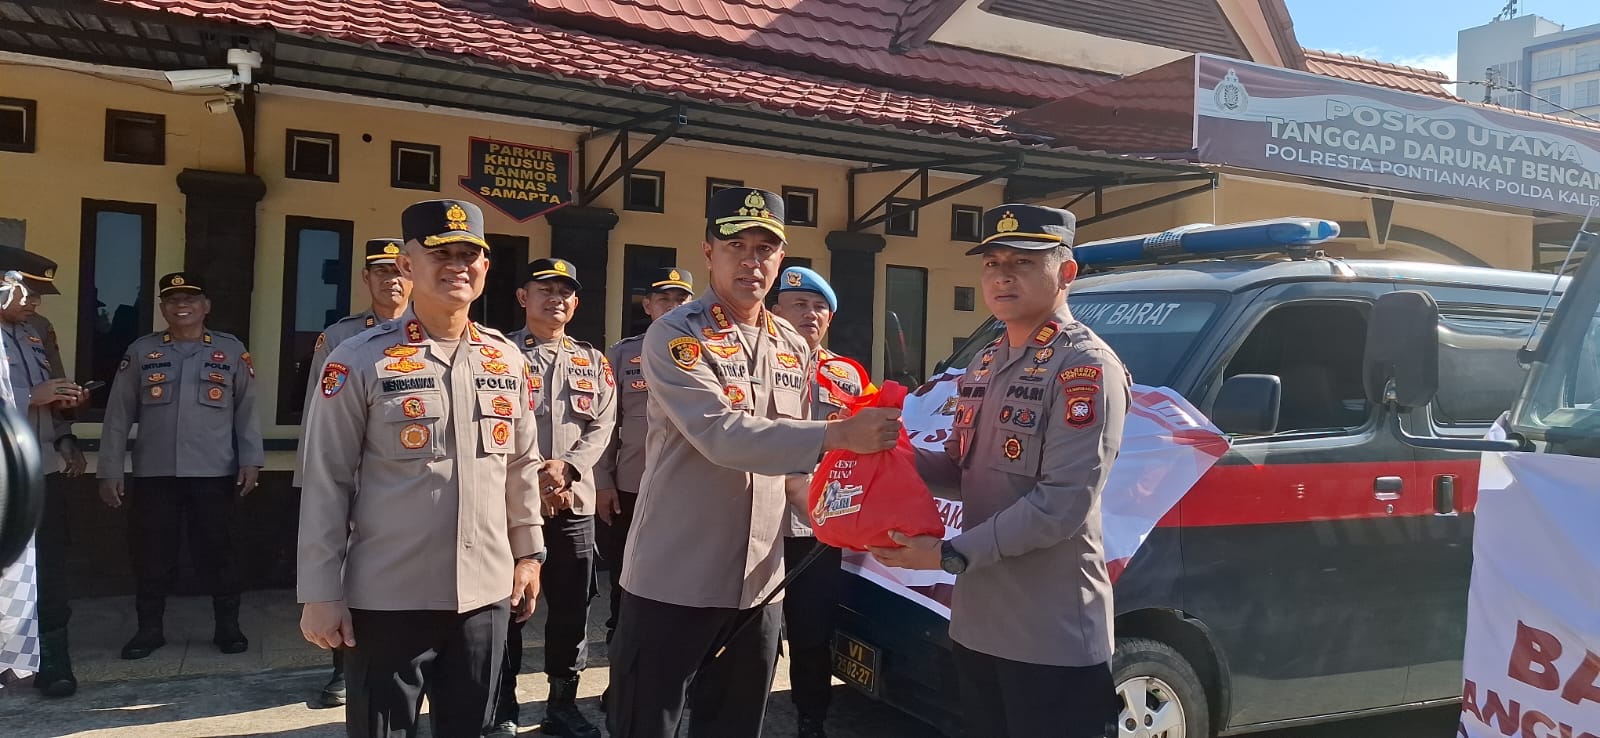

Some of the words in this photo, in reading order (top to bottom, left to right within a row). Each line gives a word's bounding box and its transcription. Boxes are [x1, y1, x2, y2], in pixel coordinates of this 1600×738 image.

[1326, 98, 1456, 140] POSKO
[1467, 125, 1584, 166] UTAMA
[489, 143, 553, 161] PARKIR
[1265, 115, 1396, 155] TANGGAP
[1403, 139, 1516, 175] DARURAT
[484, 153, 556, 172] KHUSUS
[1265, 143, 1375, 173] POLRESTA
[1380, 161, 1490, 190] PONTIANAK
[1495, 179, 1554, 201] POLDA
[483, 164, 558, 183] RANMOR
[495, 176, 547, 192] DINAS
[479, 186, 561, 205] SAMAPTA
[1106, 303, 1181, 326] BARAT
[204, 362, 231, 372] POLRI
[568, 366, 597, 378] POLRI
[475, 376, 518, 391] POLRI
[774, 372, 802, 389] POLRI
[1006, 385, 1044, 401] POLRI
[848, 640, 863, 661] VI
